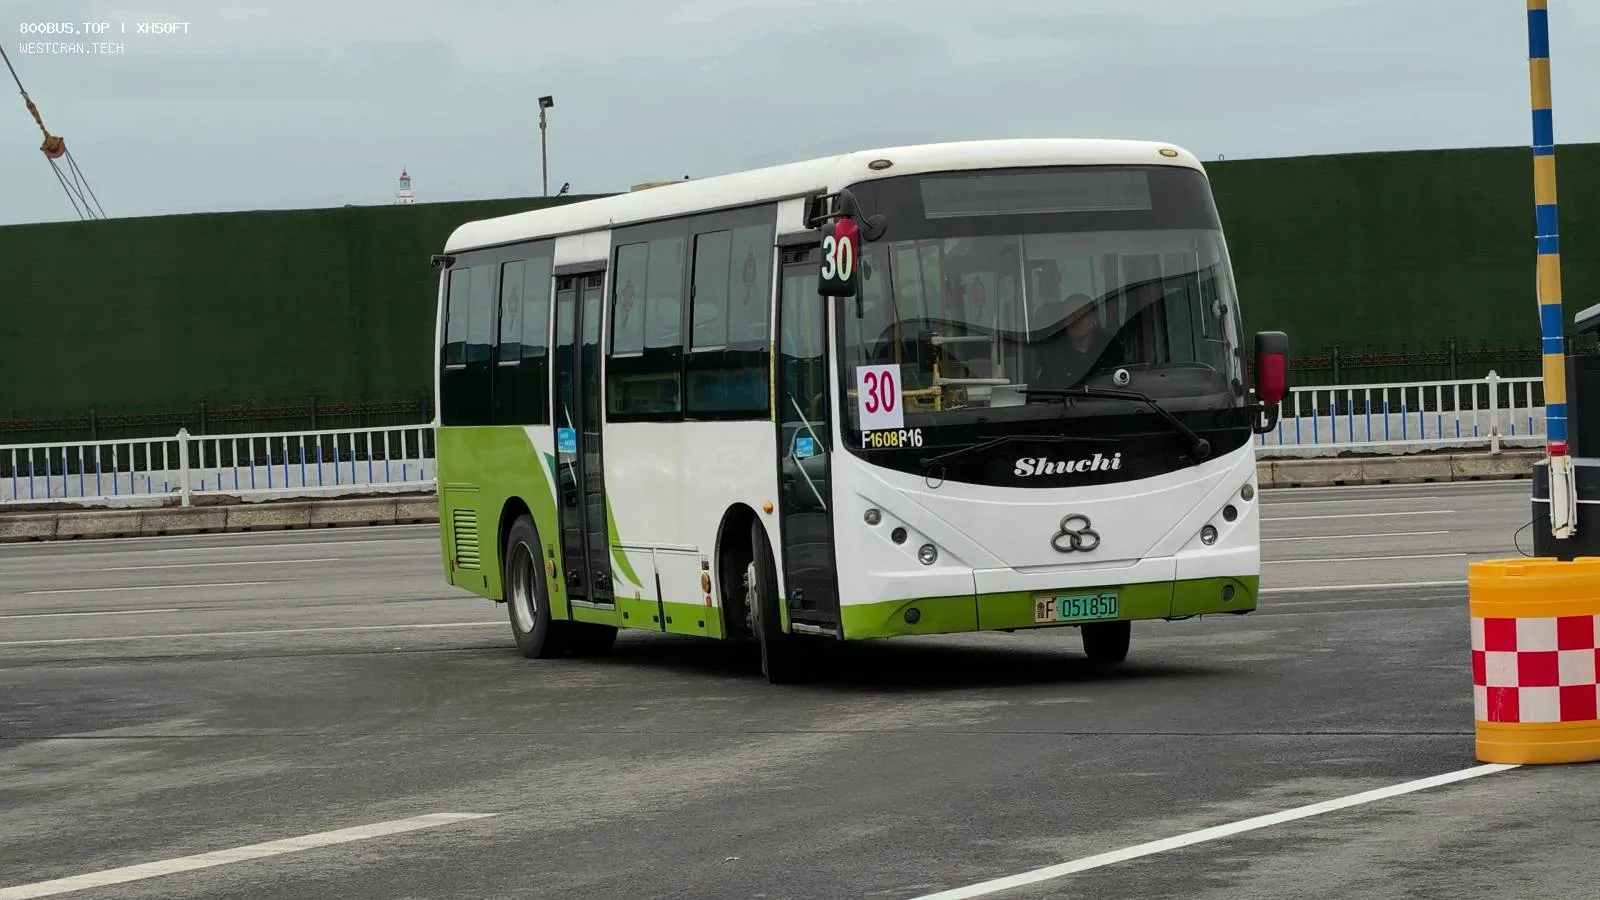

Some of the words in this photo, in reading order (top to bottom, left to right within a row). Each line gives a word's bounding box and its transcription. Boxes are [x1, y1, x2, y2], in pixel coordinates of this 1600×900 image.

[821, 235, 853, 282] 30
[863, 370, 895, 413] 30
[1014, 452, 1122, 477] Shuchi
[1062, 597, 1117, 618] 05185D
